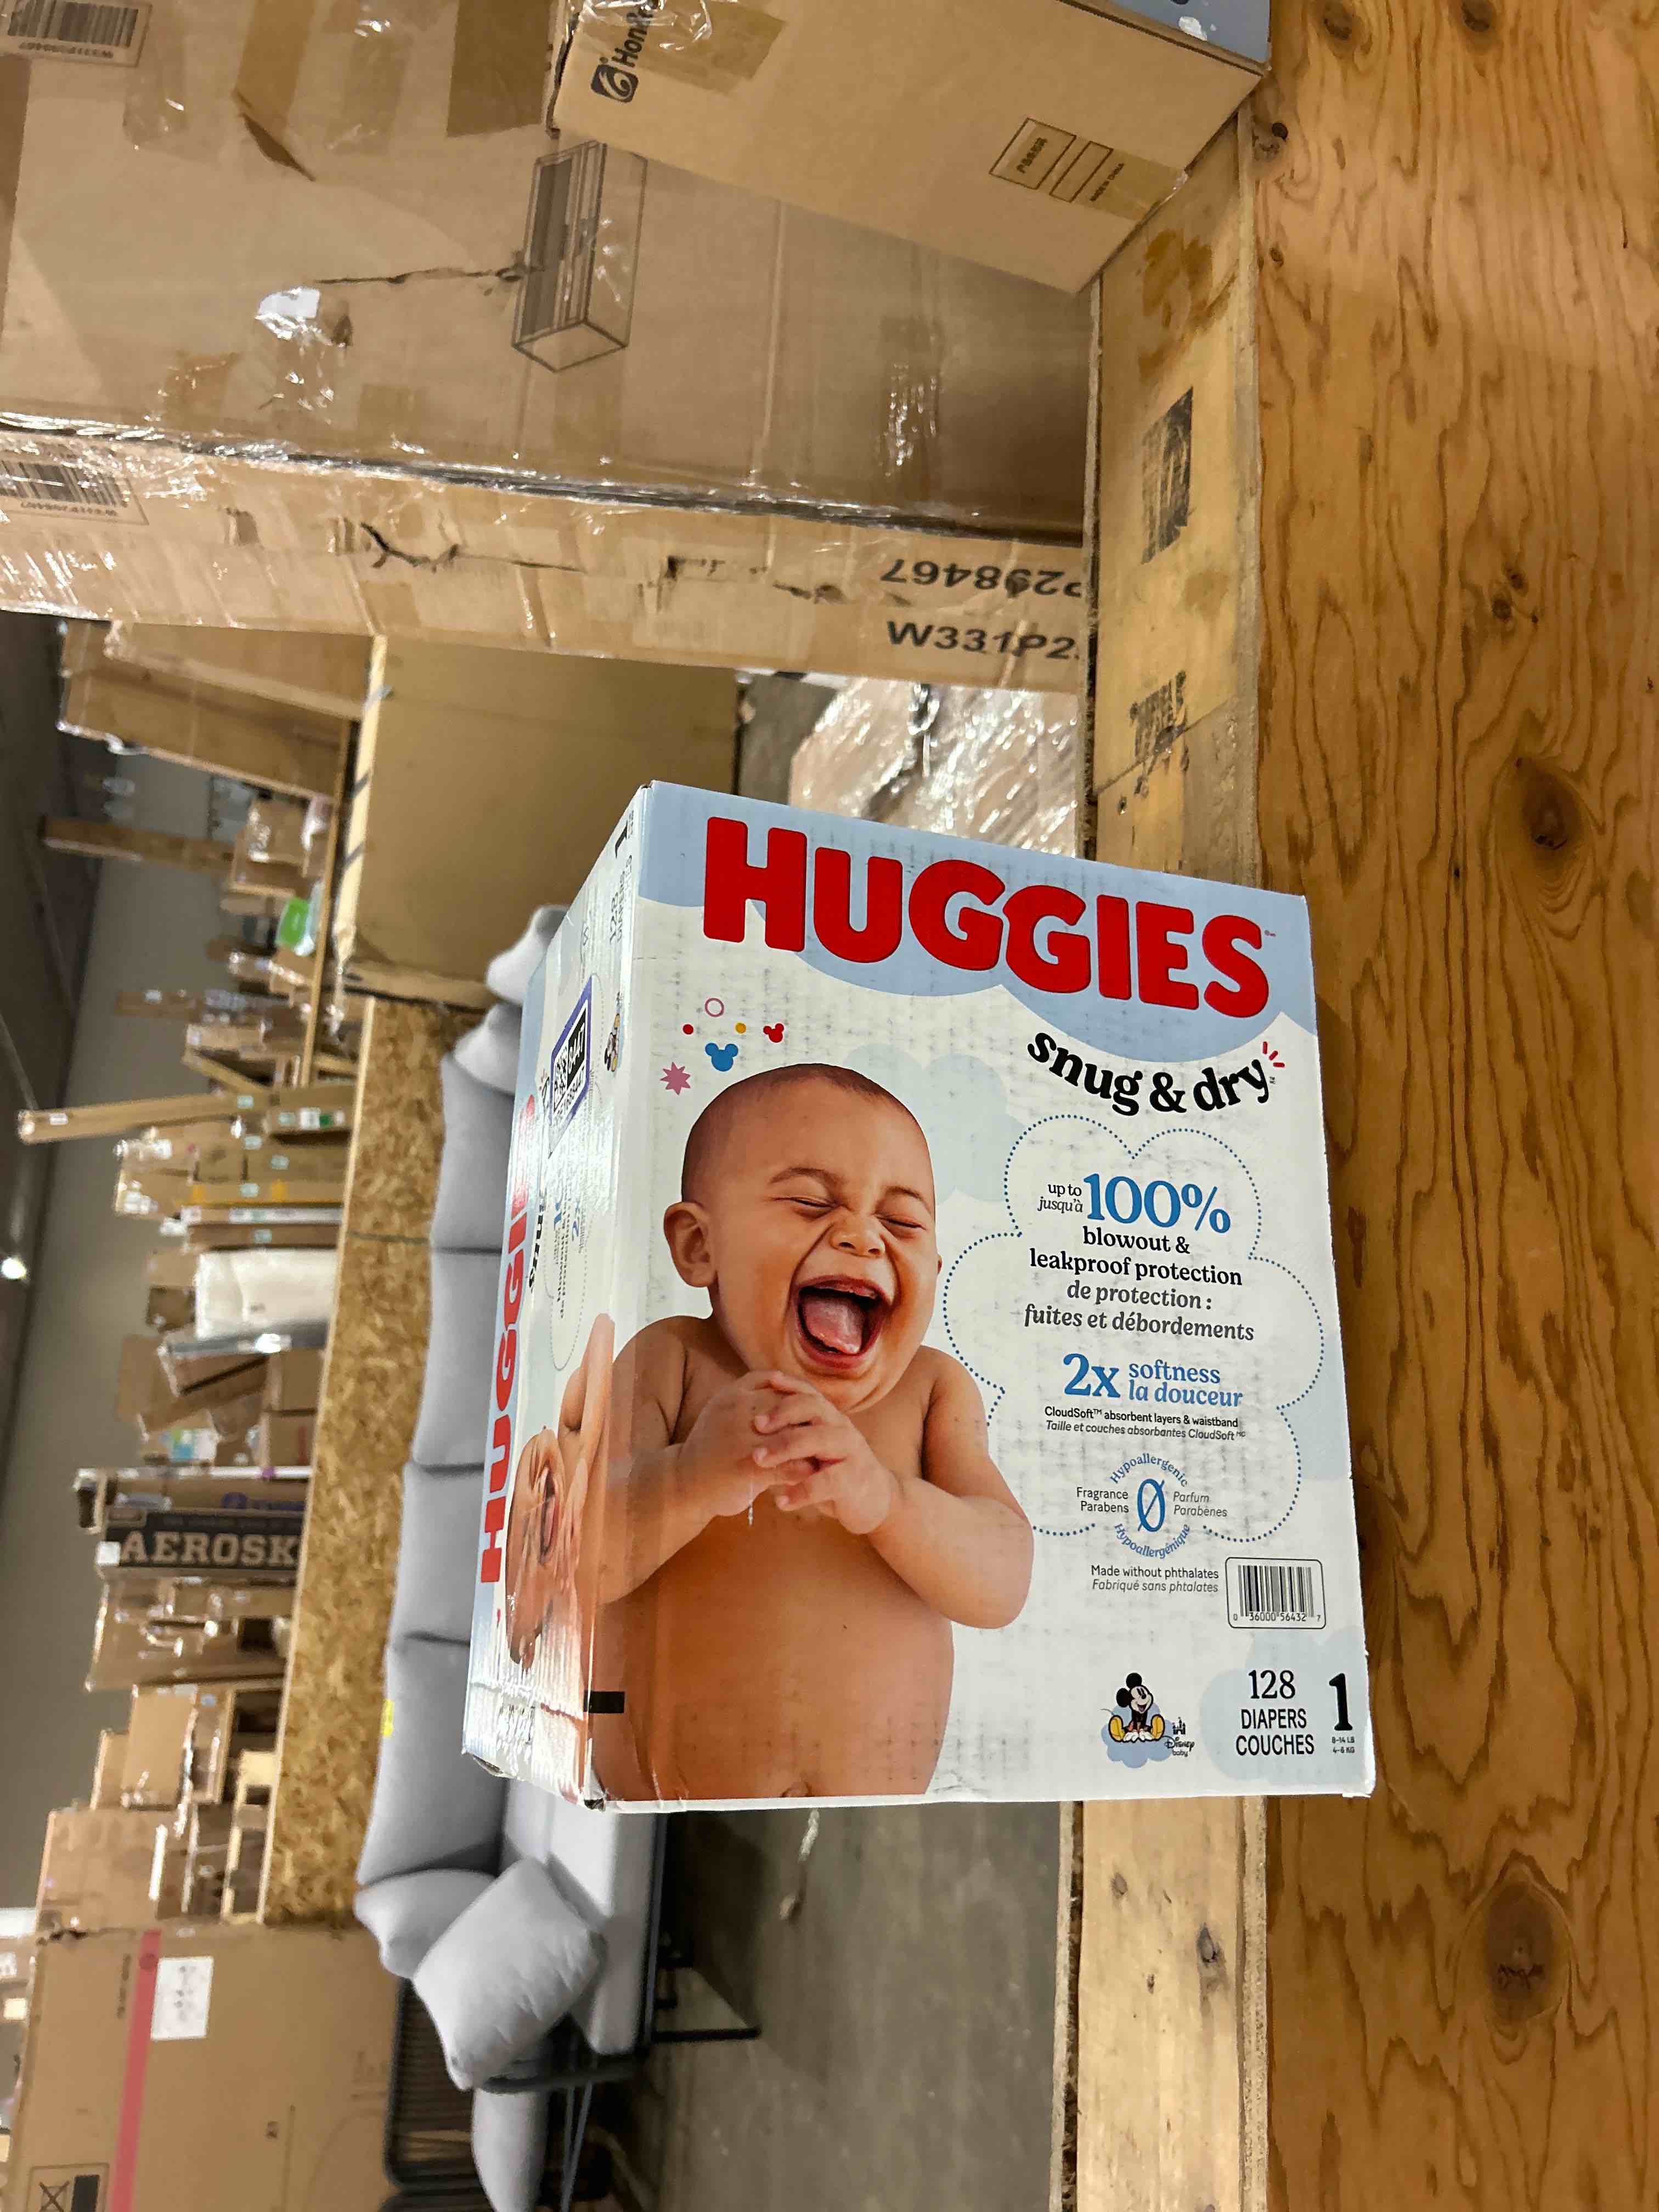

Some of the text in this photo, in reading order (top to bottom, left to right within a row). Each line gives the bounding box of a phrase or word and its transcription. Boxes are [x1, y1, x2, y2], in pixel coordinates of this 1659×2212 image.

[887, 621, 1080, 659] W331P2
[703, 816, 1269, 1019] HUGGIES
[1028, 1032, 1143, 1116] snug
[1149, 1071, 1187, 1113] &
[1047, 1183, 1082, 1198] up to
[1083, 1173, 1231, 1234] 100%
[1037, 1197, 1084, 1214] jusqu'à
[1083, 1226, 1190, 1254] blowout &
[1029, 1248, 1243, 1286] leakproof protection
[1067, 1280, 1091, 1299] de
[1095, 1285, 1201, 1310] protection
[1024, 1304, 1255, 1341] fuites et débordements
[1063, 1353, 1121, 1398] 2x
[1128, 1359, 1221, 1384] softness
[1128, 1379, 1244, 1407] la douceur
[1046, 1420, 1072, 1432] Taille
[1074, 1423, 1084, 1432] et
[1085, 1423, 1125, 1435] couches
[1127, 1426, 1186, 1438] absorbantes
[1104, 1410, 1153, 1423] absorbent
[1154, 1413, 1181, 1425] layers
[1183, 1415, 1191, 1425] &
[1192, 1415, 1238, 1428] waistband
[1110, 1452, 1188, 1487] Hypoallergenic
[1076, 1487, 1128, 1502] Fragrance
[1080, 1501, 1130, 1514] Parabens
[1173, 1491, 1210, 1503] Parfum
[1114, 1522, 1191, 1559] Hypoallergénique
[1091, 1565, 1219, 1581] Made without phthalates
[1092, 1578, 1219, 1594] Fabriqué sans phtalates
[1248, 1669, 1296, 1700] 128
[1329, 1673, 1353, 1731] 1
[1240, 1708, 1307, 1730] DIAPERS
[1235, 1734, 1315, 1756] COUCHES
